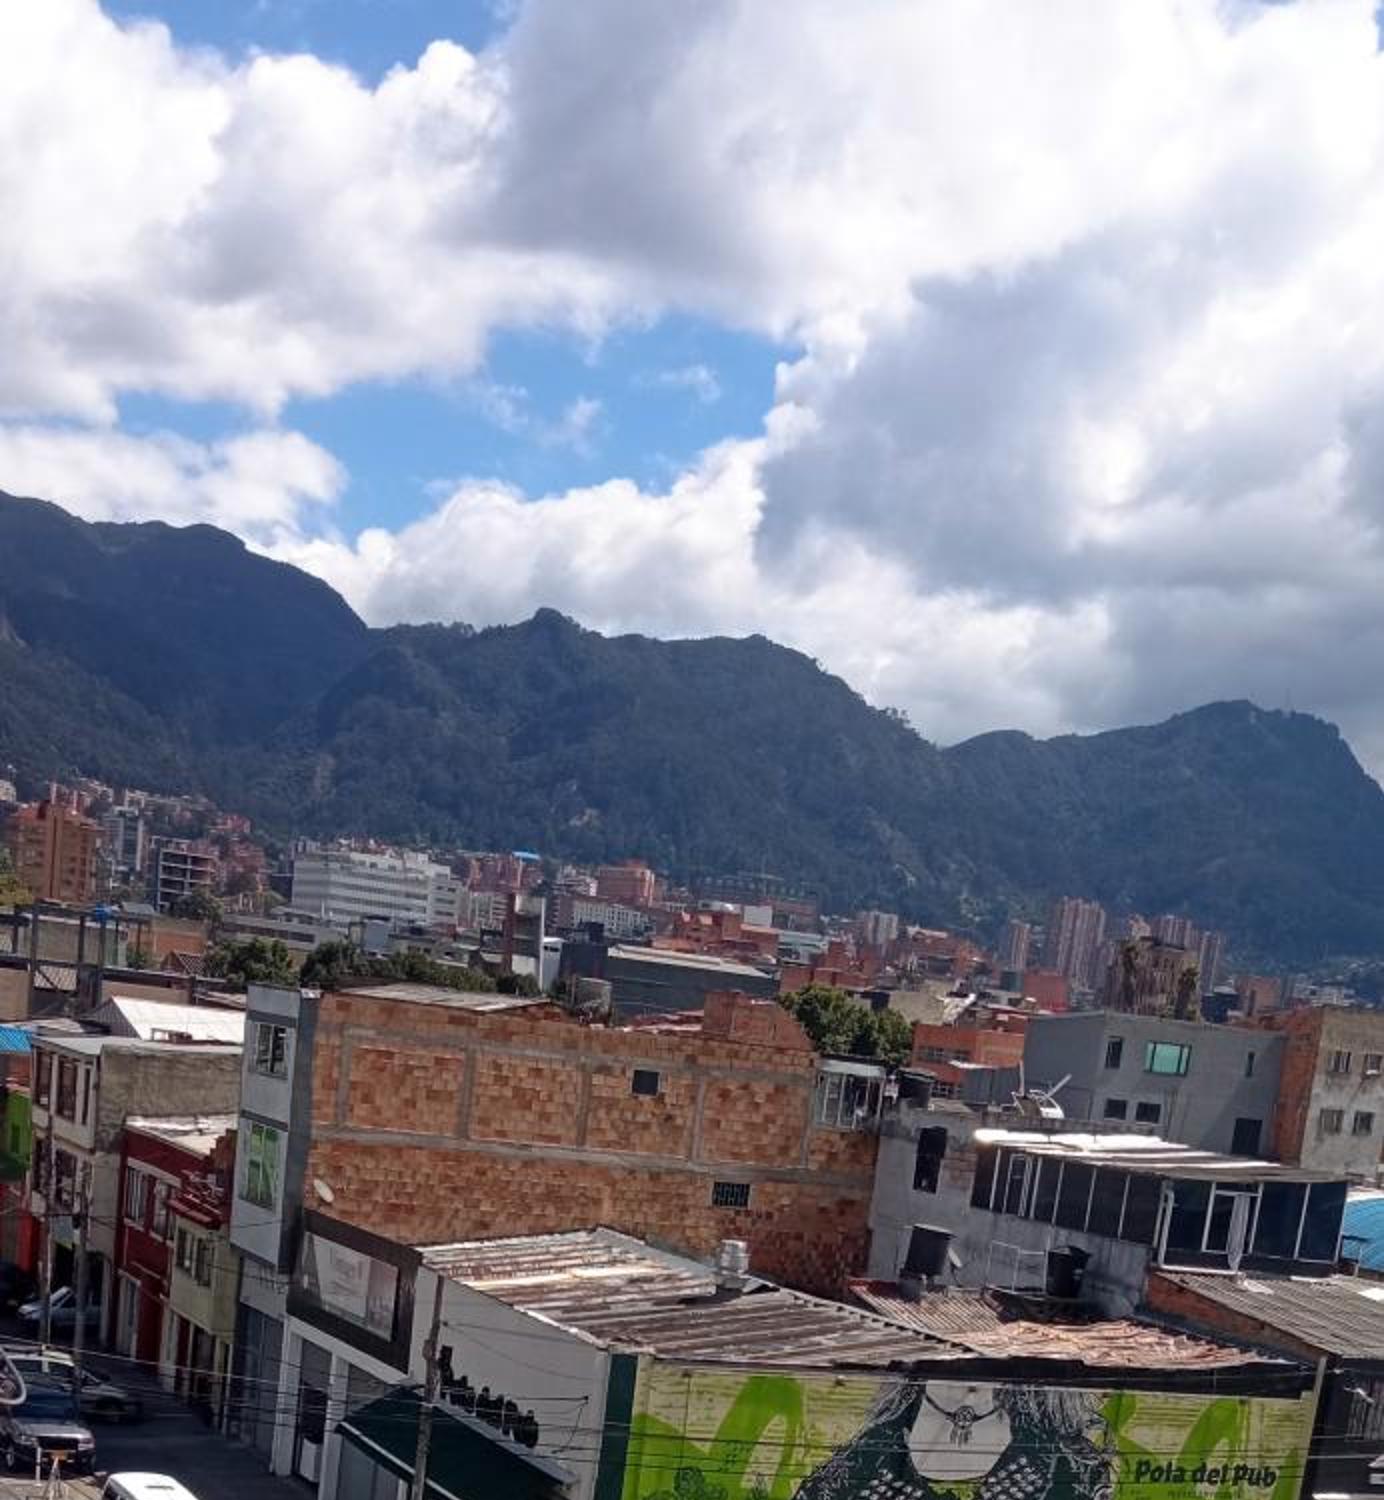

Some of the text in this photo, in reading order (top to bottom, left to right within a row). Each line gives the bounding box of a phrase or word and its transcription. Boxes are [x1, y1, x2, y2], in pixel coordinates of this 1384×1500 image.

[1135, 1459, 1277, 1487] Pola del Pub
